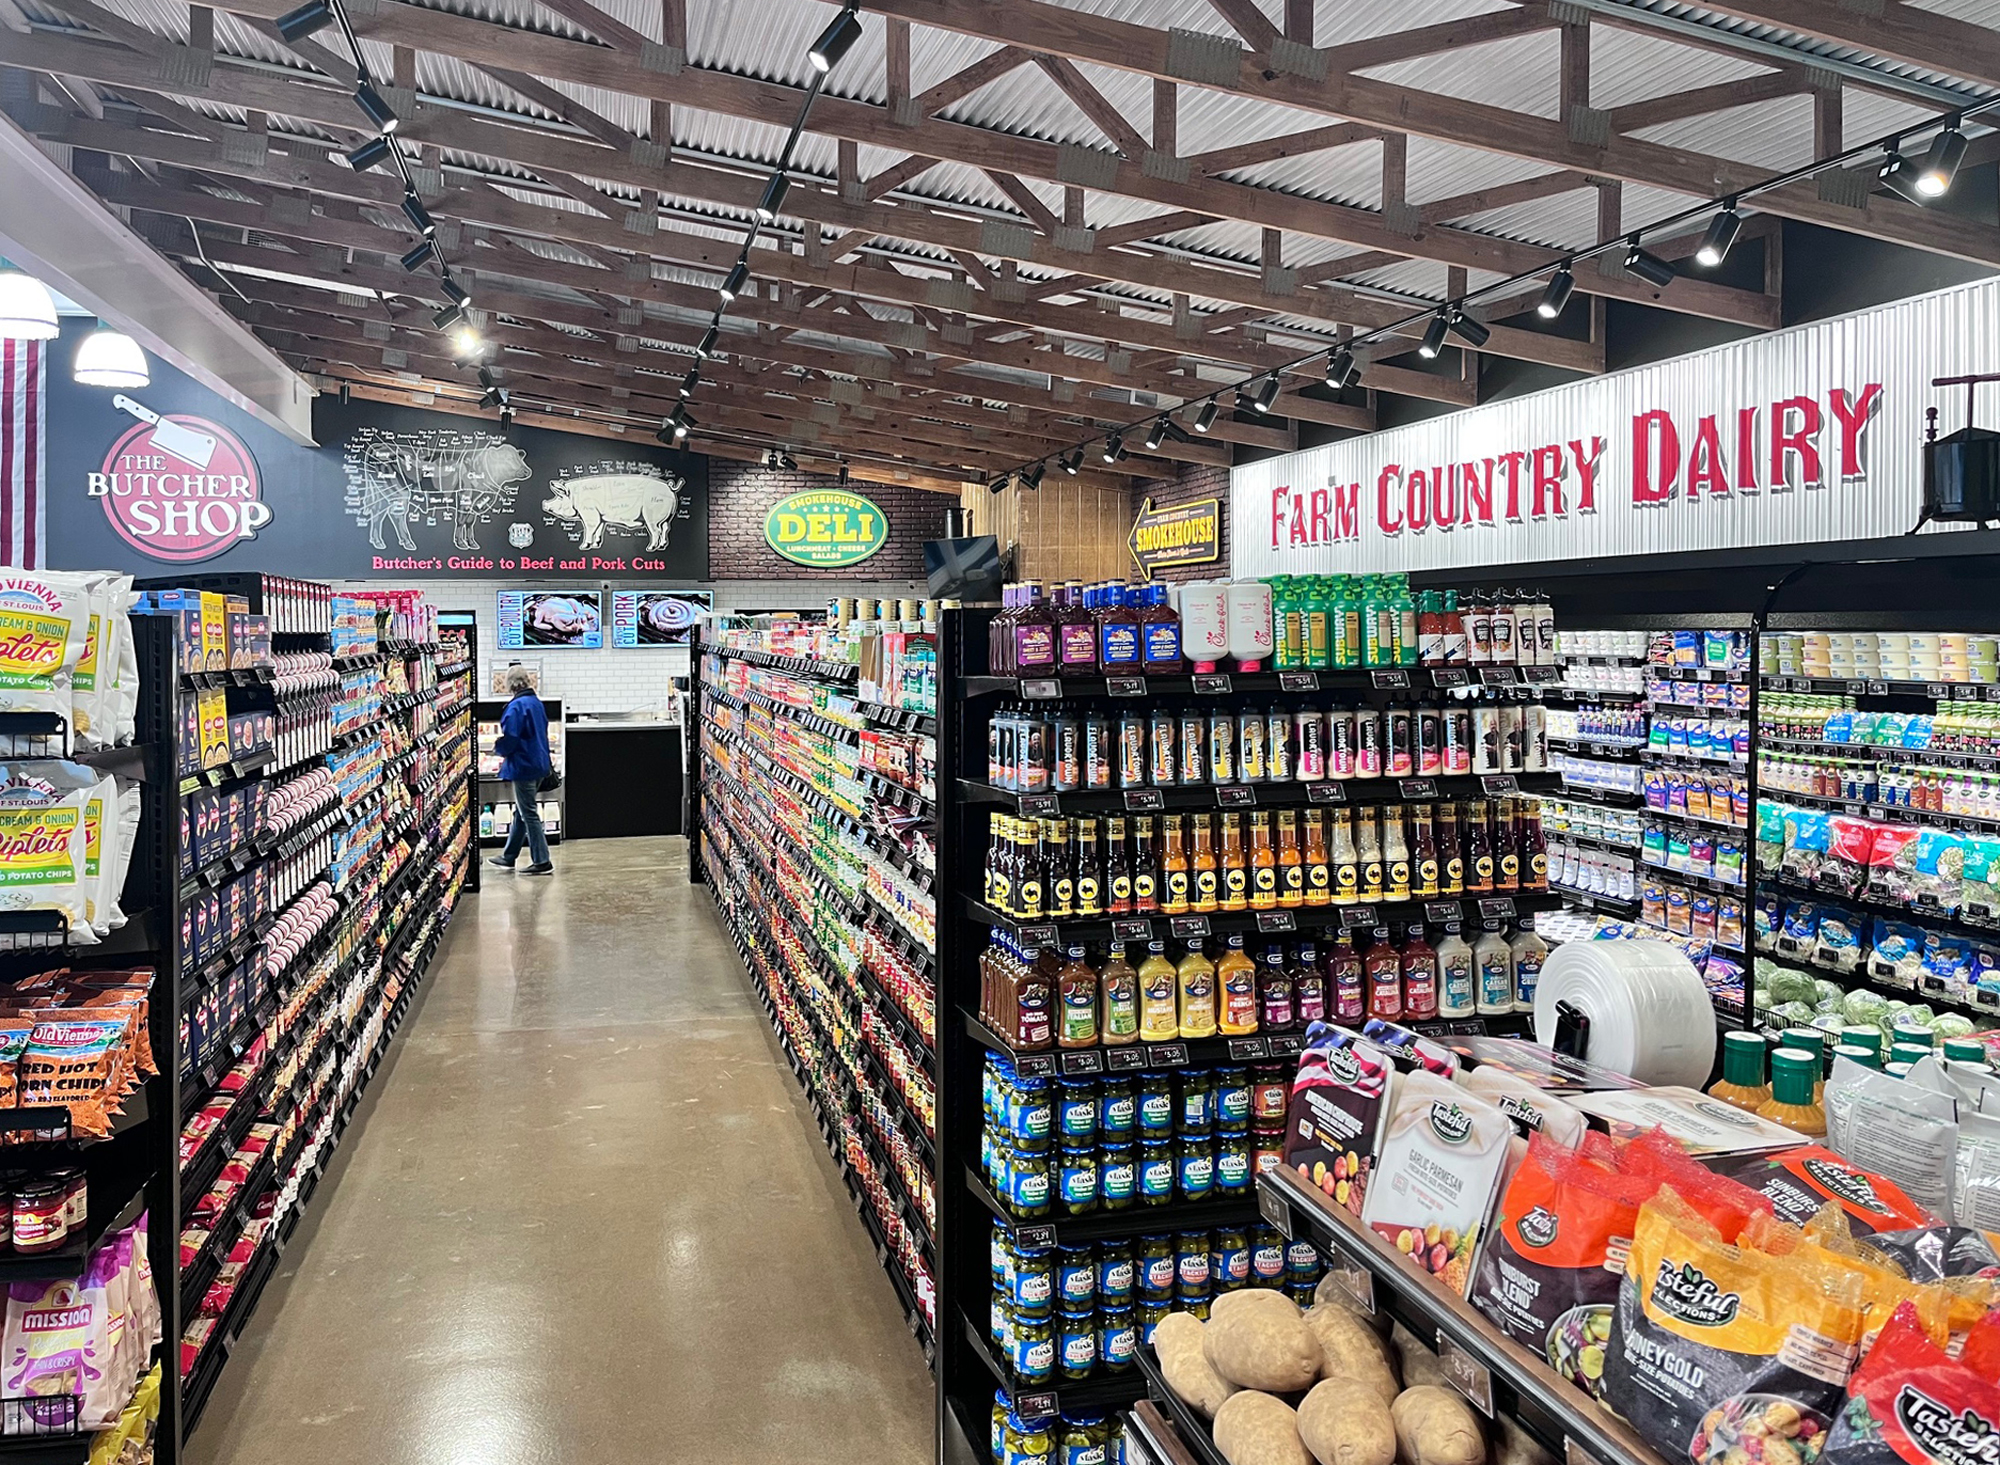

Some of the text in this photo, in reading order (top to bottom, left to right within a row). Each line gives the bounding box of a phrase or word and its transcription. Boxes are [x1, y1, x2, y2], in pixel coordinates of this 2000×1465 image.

[120, 455, 167, 471] THE
[1271, 383, 1883, 551] FARM COUNTRY DAIRY
[88, 472, 253, 498] BUTCHER
[788, 495, 863, 511] SMOKEHOUSE
[127, 500, 271, 537] SHOP
[777, 514, 874, 542] DELI
[1136, 515, 1214, 552] SMOKEHOUSE
[372, 556, 665, 570] Butcher's Guide to Beef and Pork Cuts
[786, 545, 866, 553] LUNCHMEAT CHEESE
[6, 579, 64, 612] VIENNA
[615, 594, 636, 627] PORK
[26, 619, 33, 631] &
[35, 621, 65, 636] ONION
[1275, 608, 1287, 665] SUBWAY
[1300, 608, 1310, 665] SUBWAY
[1334, 607, 1346, 665] SUBWAY
[1366, 605, 1379, 665] SUBWAY
[1390, 606, 1401, 664] SUBWAY
[0, 674, 25, 686] OTATO
[72, 677, 92, 686] HIPS
[36, 814, 42, 825] &
[45, 813, 74, 824] ONION
[8, 870, 72, 881] POTATO CHIPS
[33, 1027, 100, 1041] Old Vienna
[22, 1062, 98, 1074] RED HOT
[20, 1080, 51, 1092] ORN
[1433, 1100, 1472, 1133] Tasteful
[1501, 1095, 1543, 1127] Tasteful
[1409, 1149, 1464, 1193] GARLIC PARMESAN
[1809, 1164, 1866, 1204] SELECTIONS
[1760, 1186, 1807, 1213] BLEND
[1766, 1178, 1821, 1213] SUNBURS
[1652, 1286, 1720, 1322] ELECTIONS
[25, 1308, 90, 1329] MISSION
[54, 1356, 76, 1368] CRISPY
